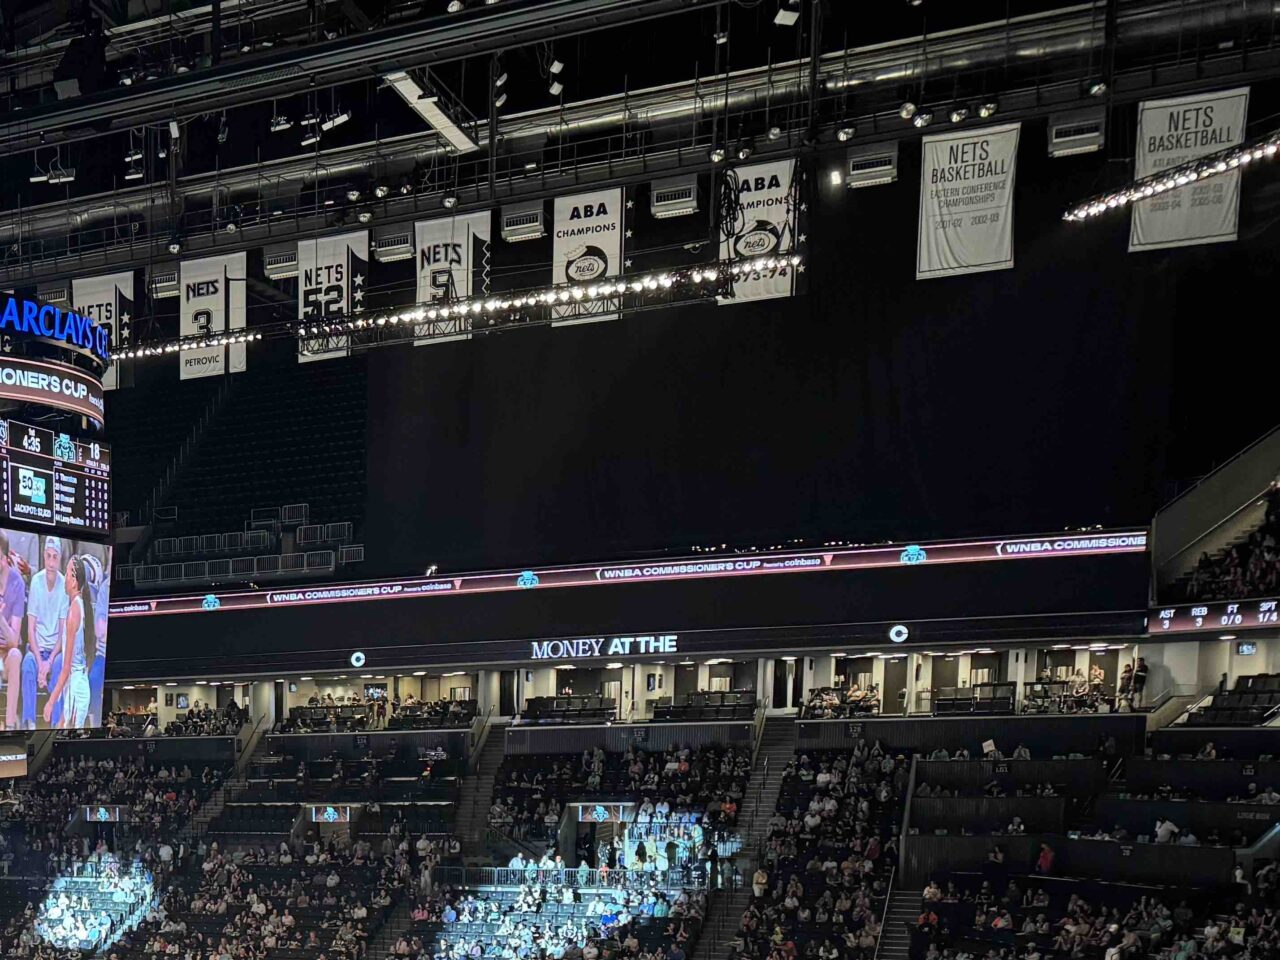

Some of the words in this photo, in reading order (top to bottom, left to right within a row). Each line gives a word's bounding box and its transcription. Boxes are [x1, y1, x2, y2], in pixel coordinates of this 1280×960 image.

[1168, 106, 1214, 132] NETS
[1148, 126, 1233, 153] BASKETBALL
[949, 140, 989, 165] NETS
[932, 159, 1007, 184] BASKETBALL
[740, 175, 781, 193] ABA
[930, 187, 960, 200] EASTERN
[962, 179, 1006, 196] CONFERENCE
[738, 195, 789, 211] AMPIONS
[938, 193, 995, 209] CHAMPIONSHIPS
[569, 202, 608, 220] ABA
[556, 222, 616, 238] CHAMPIONS
[421, 243, 462, 271] NETS
[304, 264, 344, 288] NETS
[575, 262, 595, 273] nets
[733, 267, 787, 284] 973-74
[186, 279, 219, 304] NETS
[192, 308, 214, 343] 3
[184, 355, 220, 367] PETROVIC
[62, 378, 88, 399] CUP
[23, 435, 40, 452] 4:35
[89, 443, 100, 460] 18
[1006, 542, 1052, 553] WNBA
[604, 568, 641, 579] WNBA
[643, 562, 734, 576] COMMISSIONER'S
[736, 560, 761, 570] CUP
[784, 557, 821, 567] coinbase
[273, 592, 304, 602] WNBA
[305, 587, 379, 599] COMMISSIONER'S
[381, 585, 402, 594] CUP
[421, 582, 452, 591] coinbase
[1160, 609, 1176, 618] AST
[1191, 607, 1208, 616] REB
[1227, 604, 1239, 613] FT
[1259, 601, 1278, 611] 3PT
[1163, 620, 1170, 629] 3
[1196, 617, 1202, 627] 3
[531, 638, 605, 659] MONEY
[608, 638, 635, 655] AT
[636, 635, 678, 653] THE
